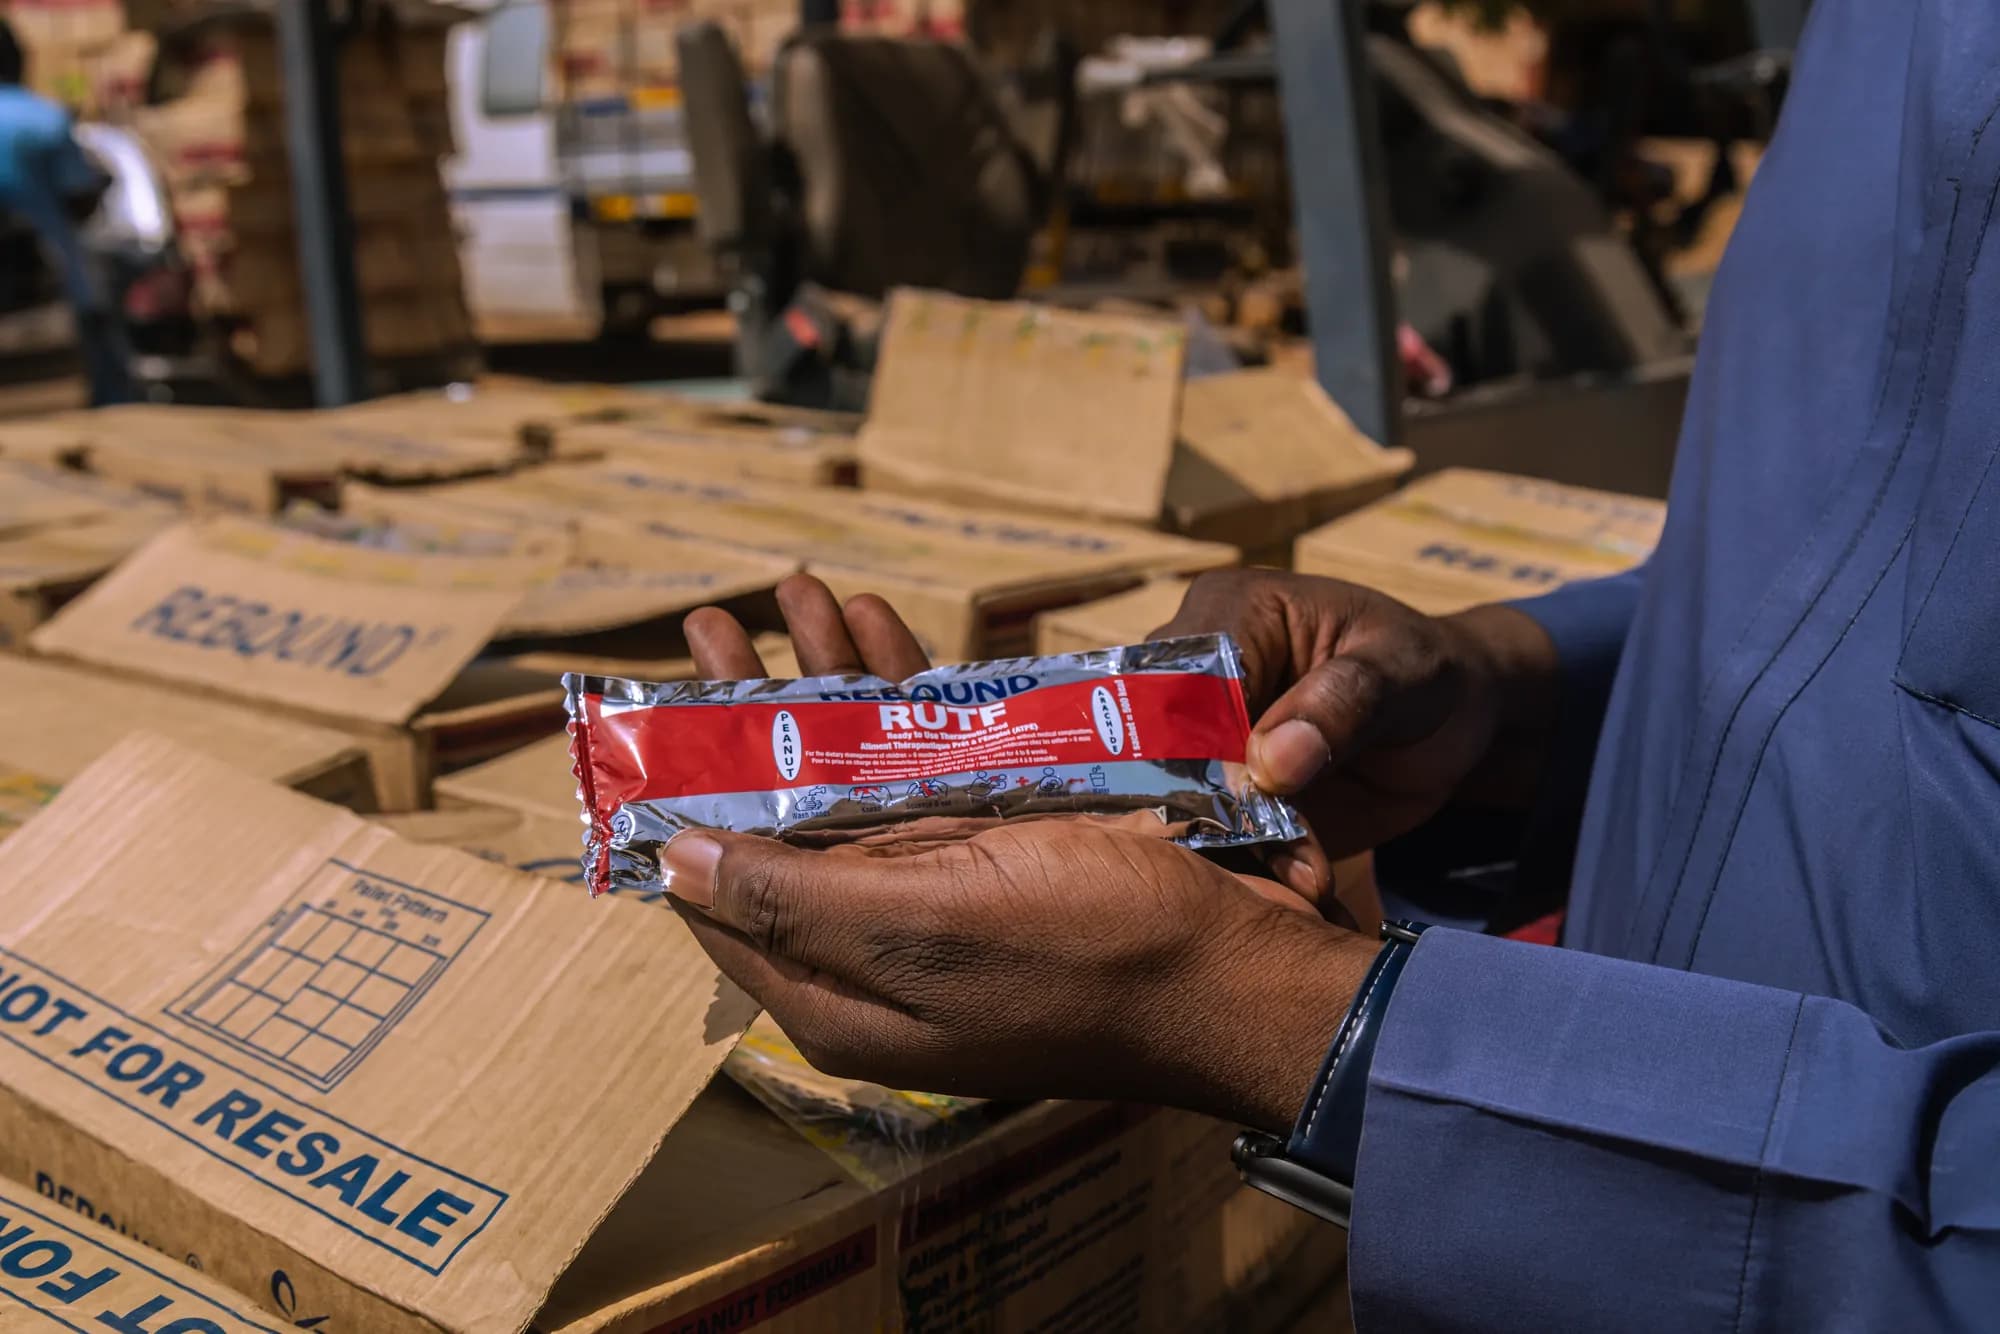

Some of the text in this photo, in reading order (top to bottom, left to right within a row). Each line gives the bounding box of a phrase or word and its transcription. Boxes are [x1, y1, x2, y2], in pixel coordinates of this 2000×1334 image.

[131, 585, 416, 677] REBOUND
[780, 713, 795, 777] PEANUT
[860, 741, 892, 750] Aliment
[879, 702, 1007, 731] RUTF
[886, 731, 912, 740] Ready
[913, 730, 923, 739] to
[923, 730, 939, 740] Use
[988, 721, 1008, 733] Food
[1098, 690, 1118, 753] ARACHIDE
[68, 1026, 206, 1109] FOR
[192, 1088, 475, 1248] RESALE
[671, 1292, 759, 1334] EANUT
[765, 1242, 864, 1312] FORMULA
